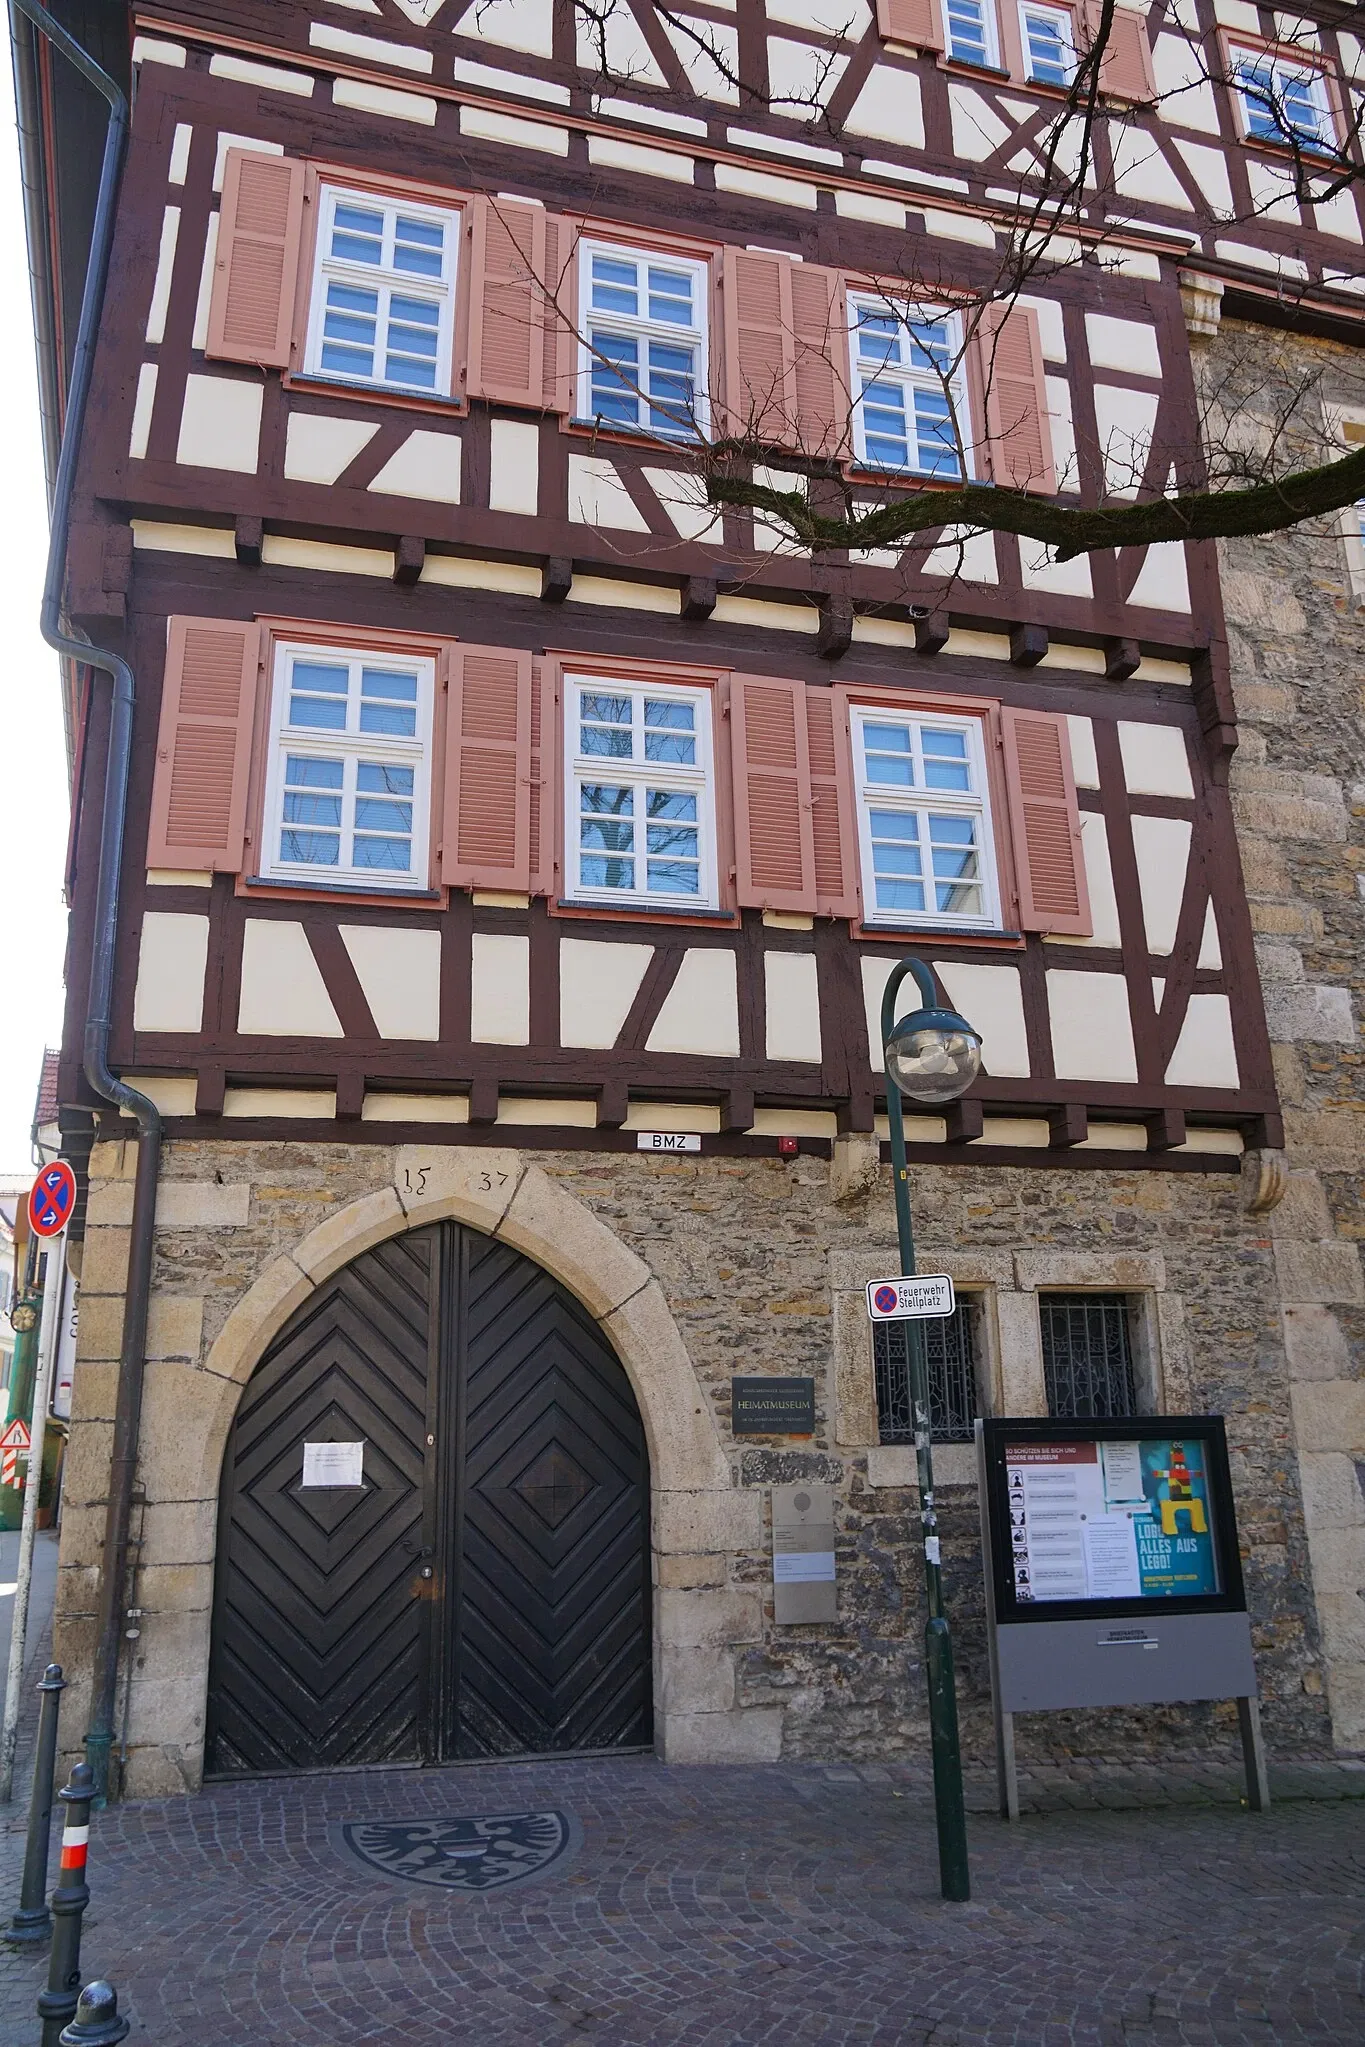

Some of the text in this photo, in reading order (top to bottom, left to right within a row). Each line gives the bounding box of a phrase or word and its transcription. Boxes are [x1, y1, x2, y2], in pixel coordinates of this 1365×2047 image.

[652, 1134, 686, 1149] BMZ
[478, 1170, 509, 1192] 37
[898, 1283, 946, 1298] Feuerwehr
[899, 1296, 941, 1310] Stellplatz
[737, 1400, 811, 1409] HEIMATMUSEUM
[1140, 1539, 1172, 1555] ALLES
[1177, 1538, 1198, 1553] AUS
[1141, 1554, 1171, 1570] LEGO!
